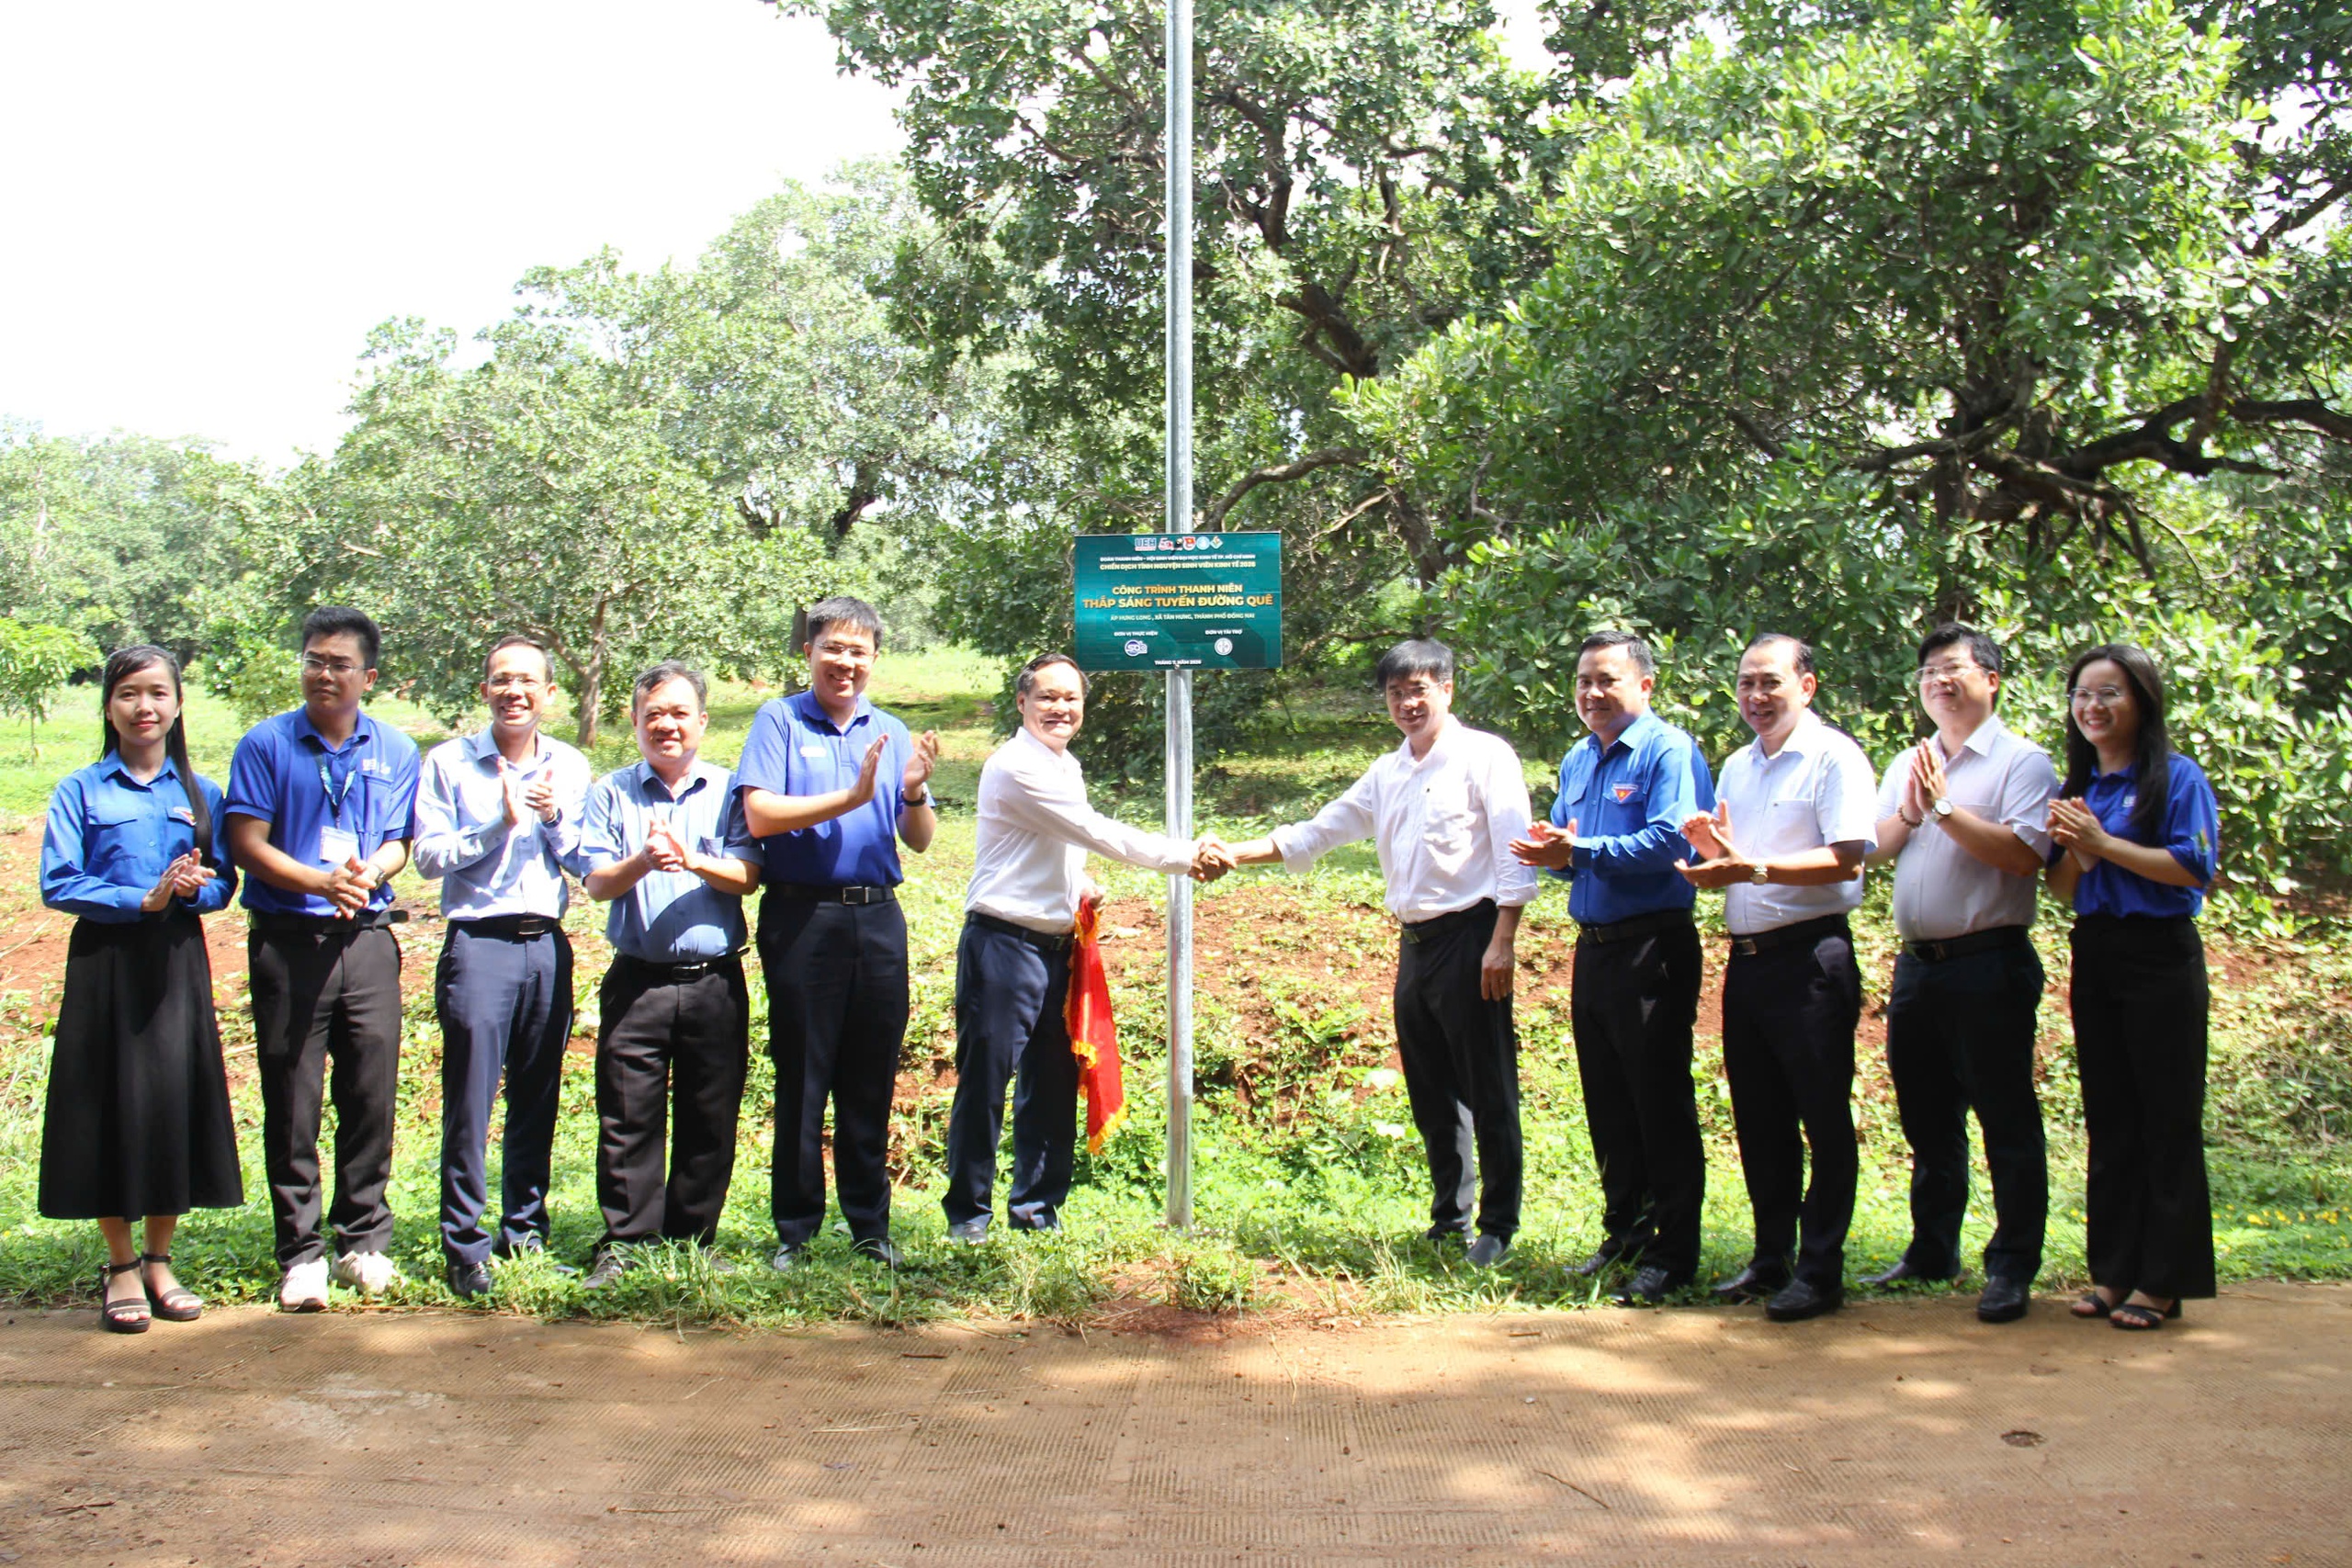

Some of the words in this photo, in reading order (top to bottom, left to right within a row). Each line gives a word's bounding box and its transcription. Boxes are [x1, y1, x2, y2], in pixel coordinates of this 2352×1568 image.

[1136, 538, 1156, 547] UEH
[1100, 562, 1120, 570] CHIẾN
[1154, 562, 1181, 570] NGUYỆN
[1231, 559, 1239, 568] TẾ
[1112, 584, 1142, 595] CÔNG
[1144, 584, 1176, 594] TRÌNH
[1178, 584, 1216, 593] THANH
[1217, 582, 1243, 593] NIÊN
[1082, 595, 1116, 608] THẮP
[1118, 596, 1152, 608] SÁNG
[1155, 594, 1195, 607] TUYẾN
[1197, 594, 1244, 606] ĐƯỜNG
[1247, 594, 1273, 607] QUÊ
